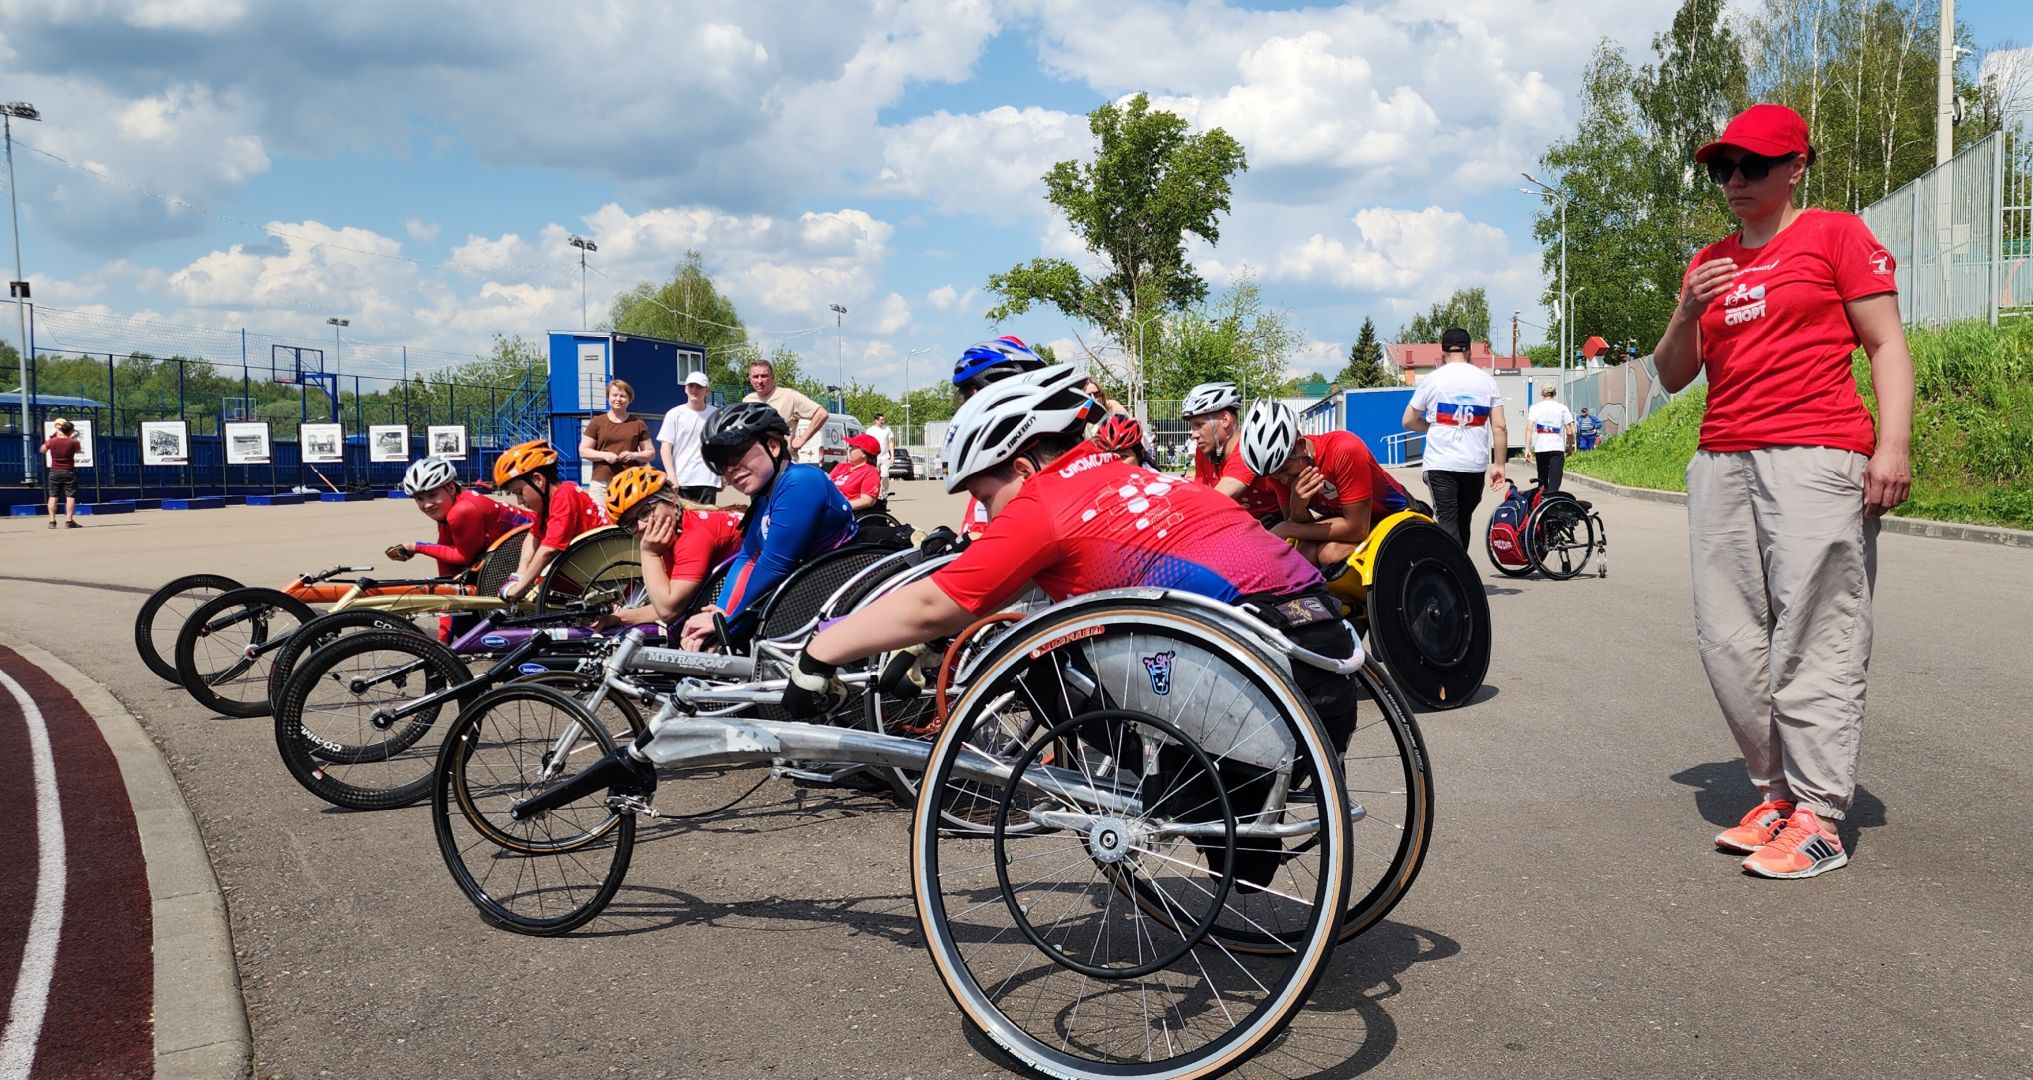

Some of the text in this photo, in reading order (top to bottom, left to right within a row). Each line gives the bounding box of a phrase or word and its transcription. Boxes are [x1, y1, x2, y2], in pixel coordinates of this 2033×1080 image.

[1724, 304, 1766, 326] СПОРТ
[1452, 405, 1475, 425] 46
[1006, 415, 1038, 450] BIKEBOY
